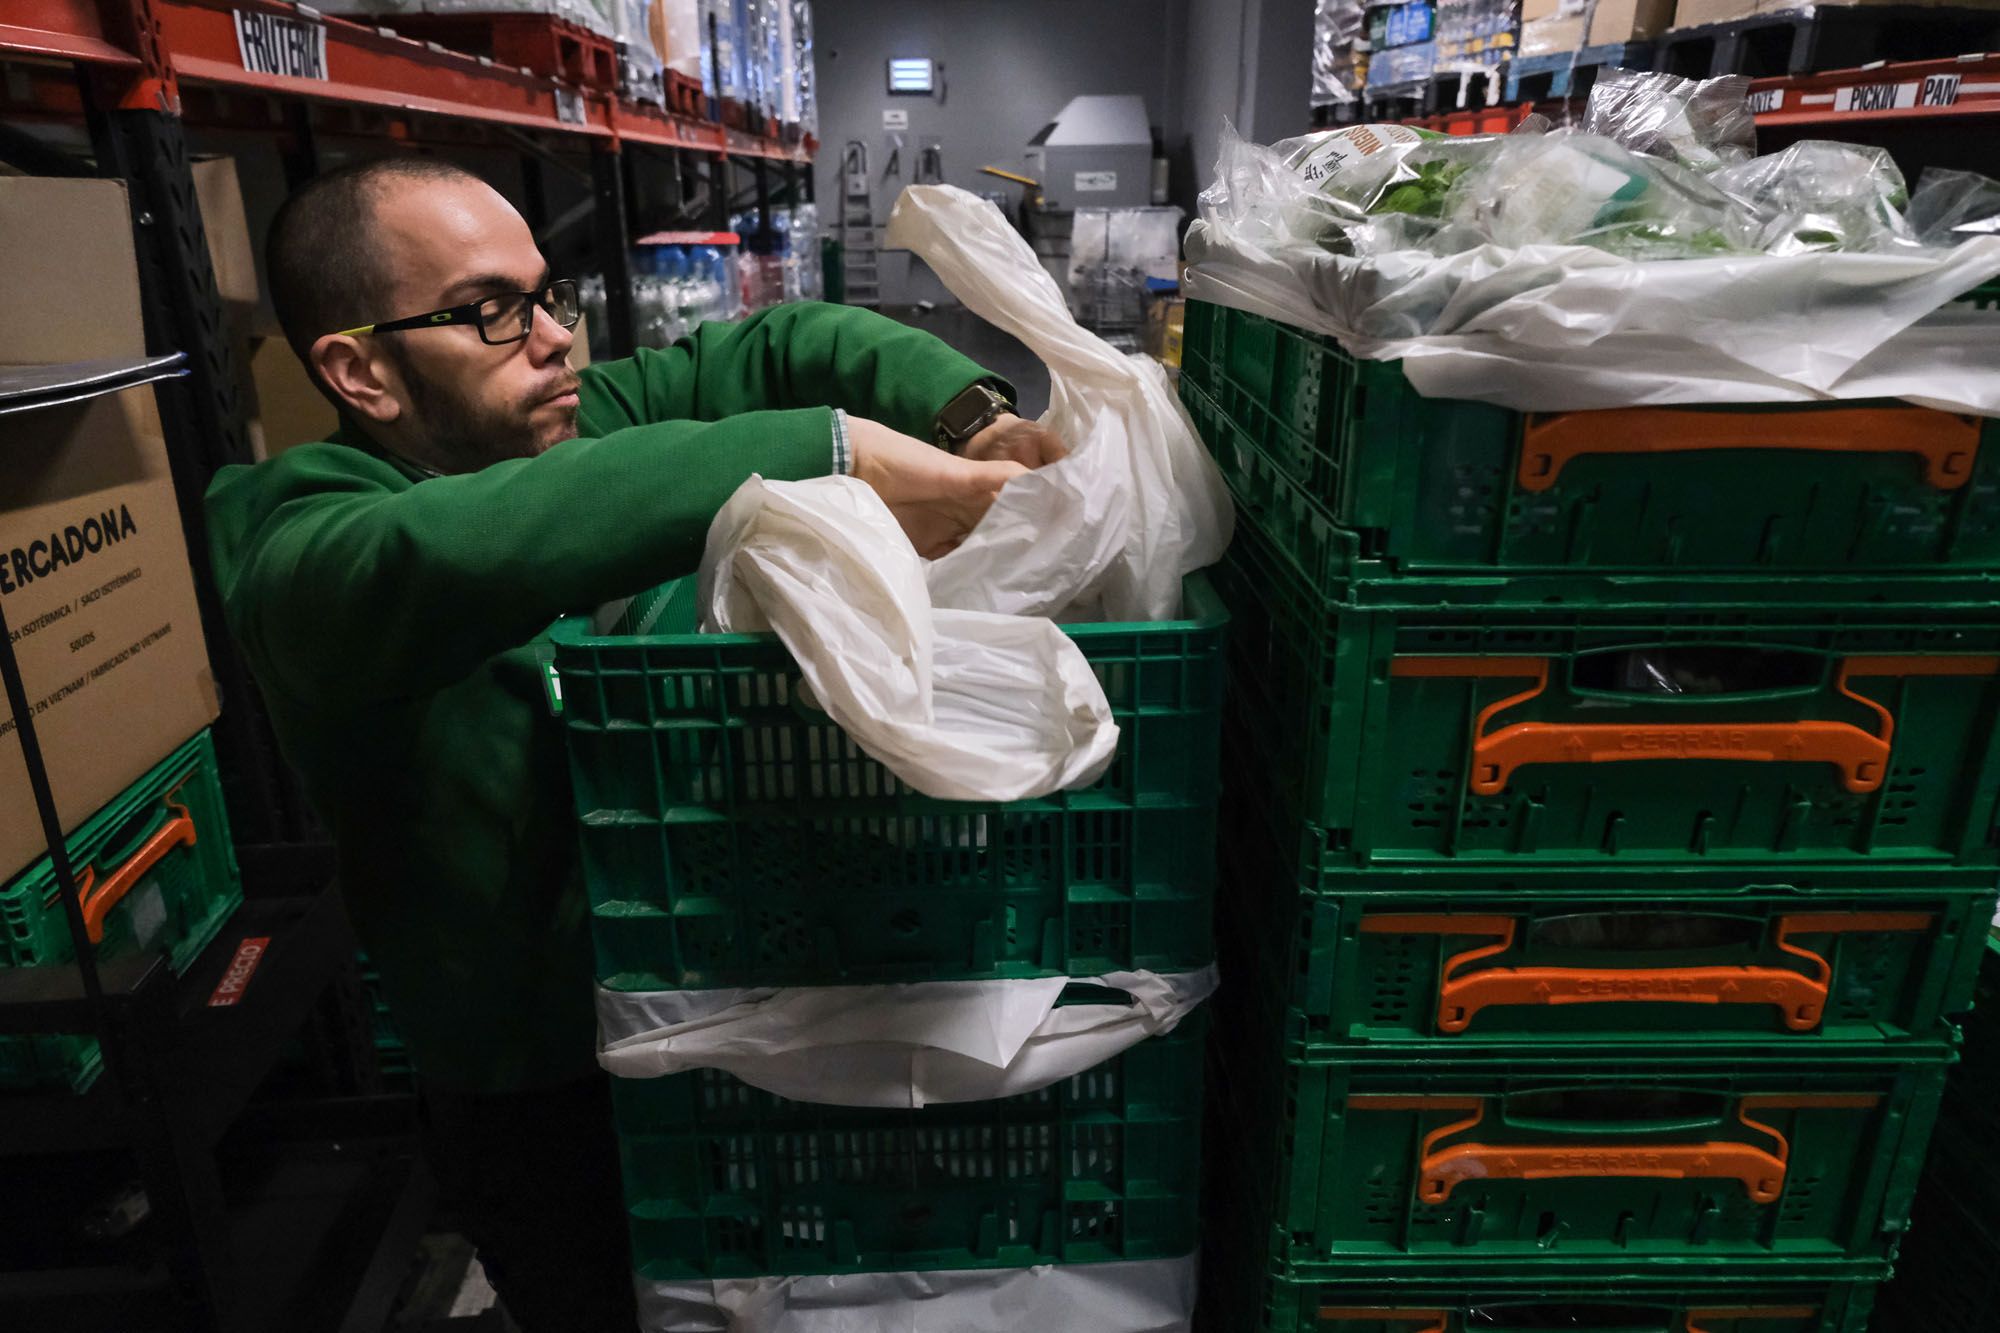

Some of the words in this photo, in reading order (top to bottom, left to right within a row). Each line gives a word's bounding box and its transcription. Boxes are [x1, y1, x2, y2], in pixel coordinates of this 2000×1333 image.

[1850, 84, 1899, 110] PICKIN
[1923, 76, 1959, 106] PAN
[0, 504, 137, 595] ERCADONA
[81, 589, 100, 607] SACO
[37, 702, 48, 714] EN
[48, 677, 85, 706] VIETNAM
[1619, 731, 1746, 750] CERRAR
